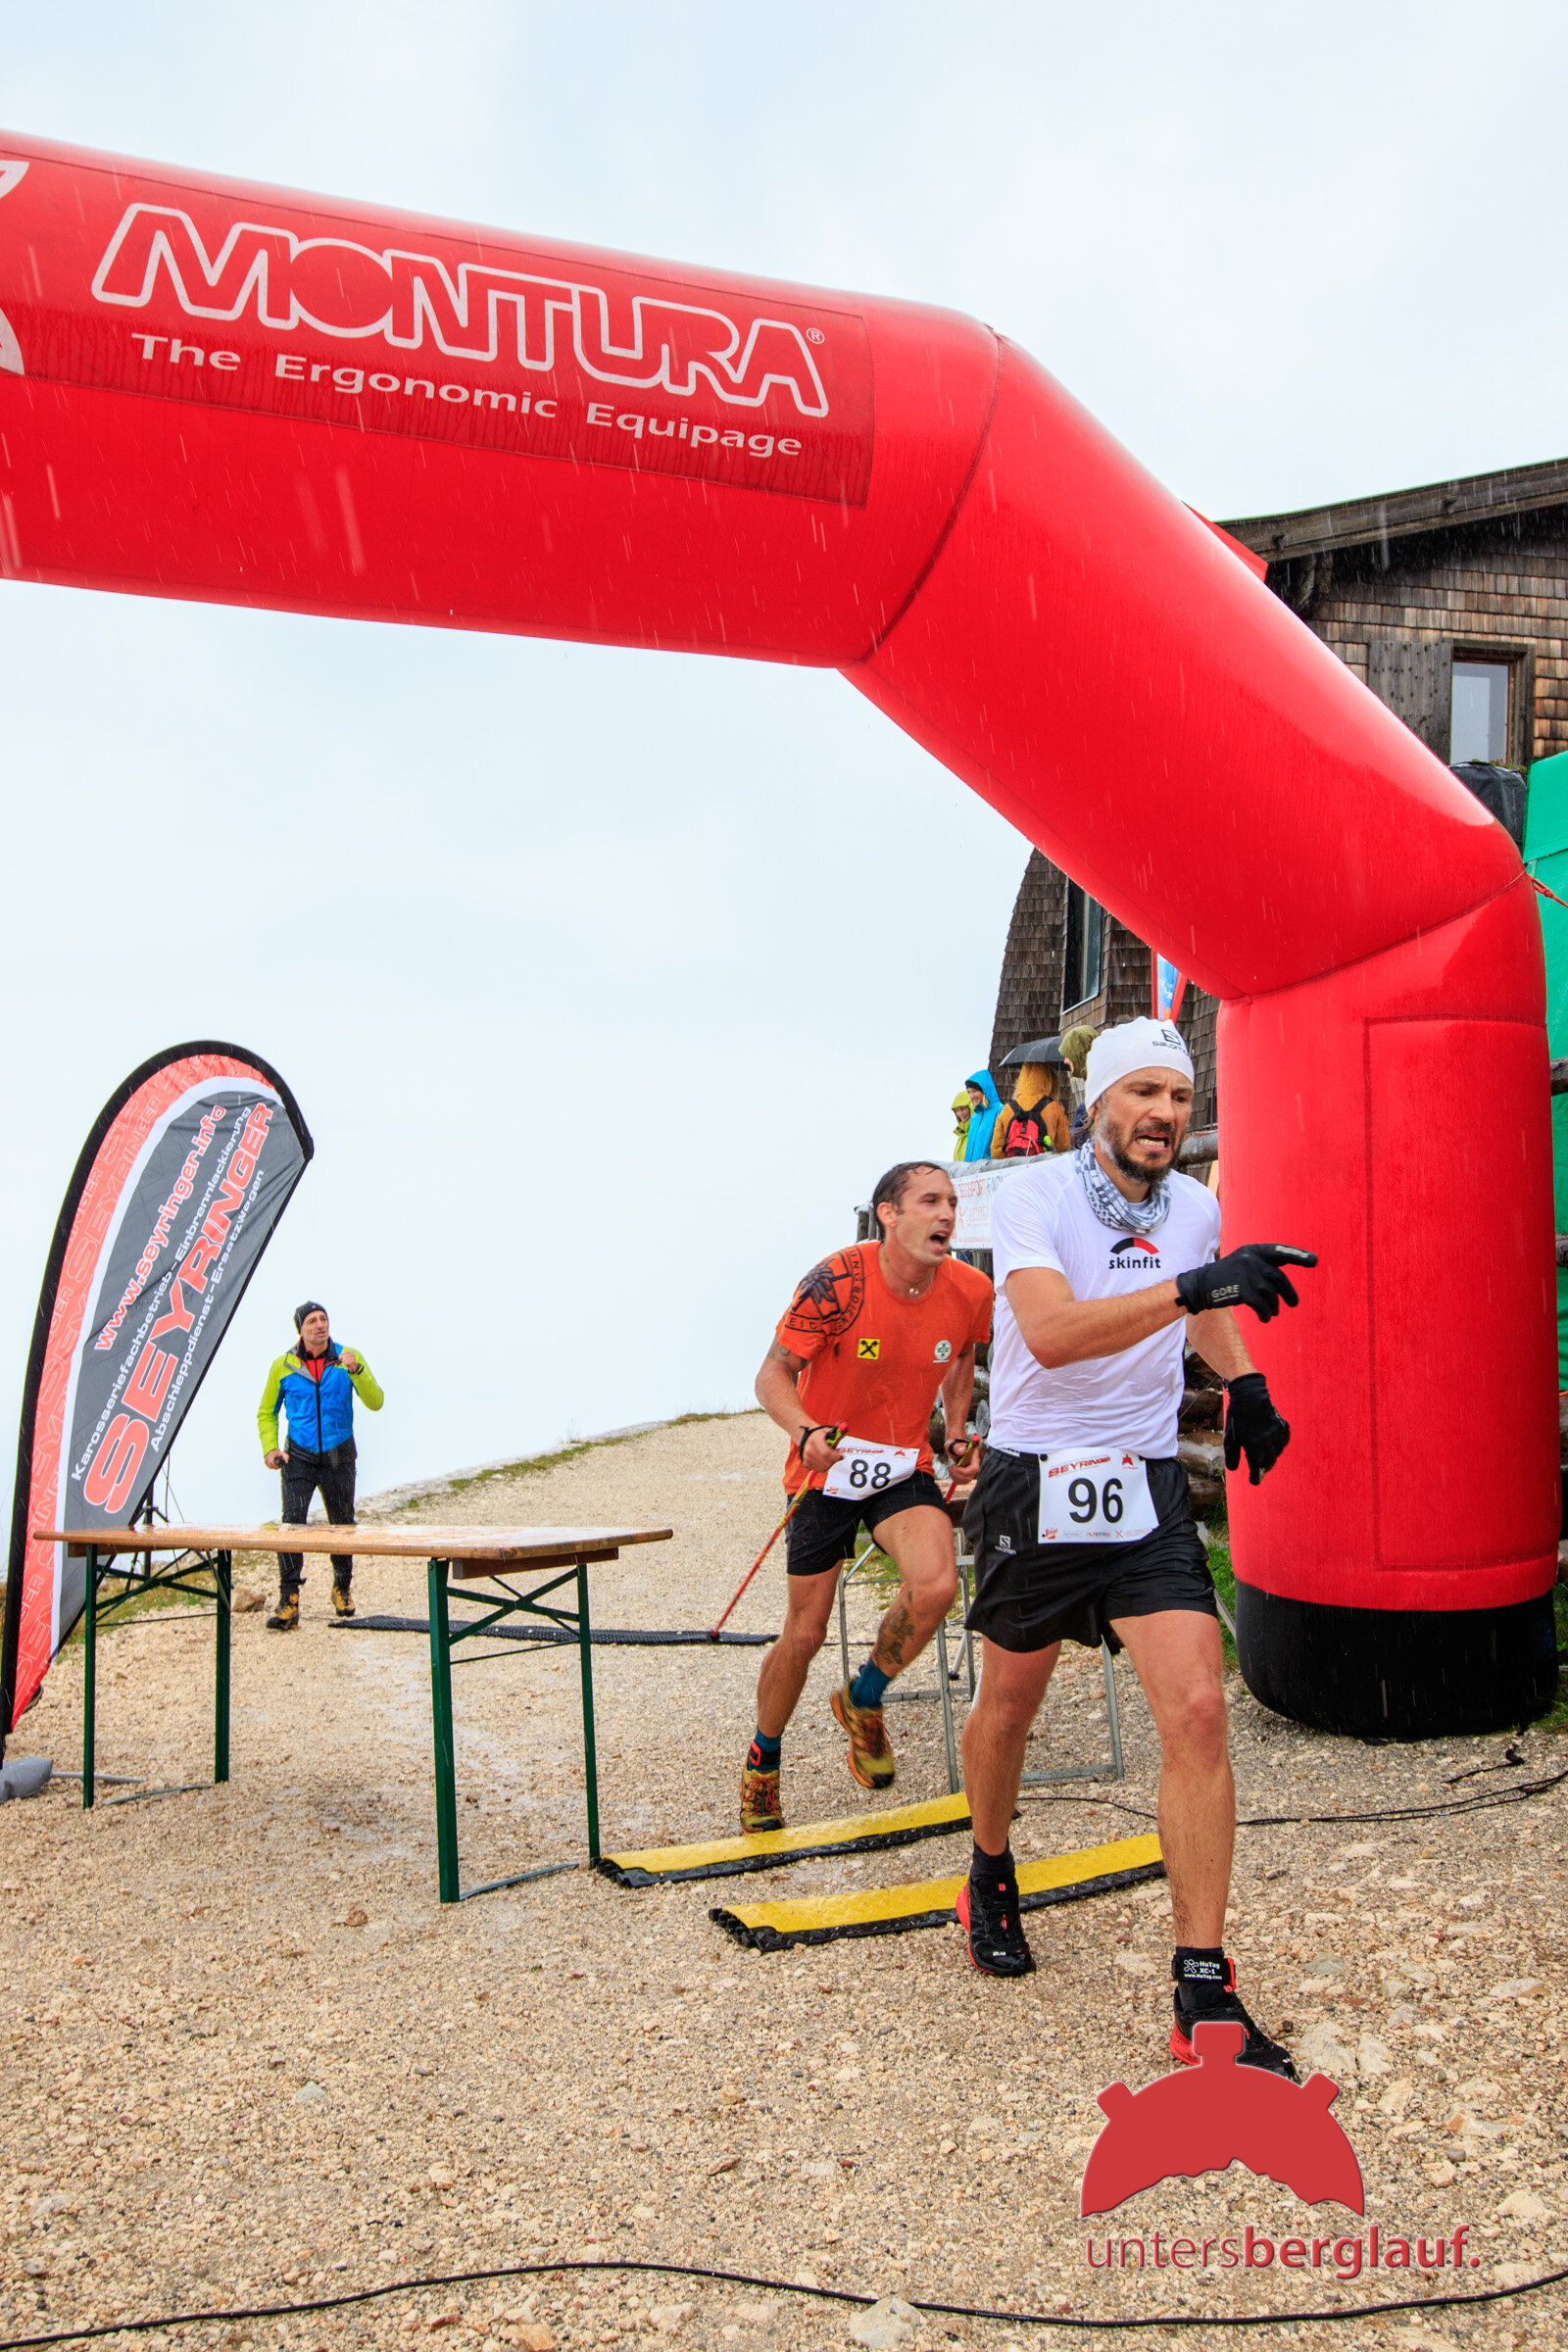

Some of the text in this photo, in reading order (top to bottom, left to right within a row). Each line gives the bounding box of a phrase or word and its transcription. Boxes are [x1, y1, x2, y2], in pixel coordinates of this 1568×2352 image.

[91, 202, 829, 418] MONTURA
[131, 333, 803, 458] The Ergonomic Equipage
[95, 1104, 226, 1350] www.seyringer.info
[1108, 1256, 1161, 1269] skinfit
[83, 1102, 273, 1514] SEYRINGER
[1211, 1285, 1240, 1298] GORE
[850, 1458, 891, 1490] 88
[1068, 1477, 1123, 1524] 96
[1200, 1961, 1221, 1970] HuTag
